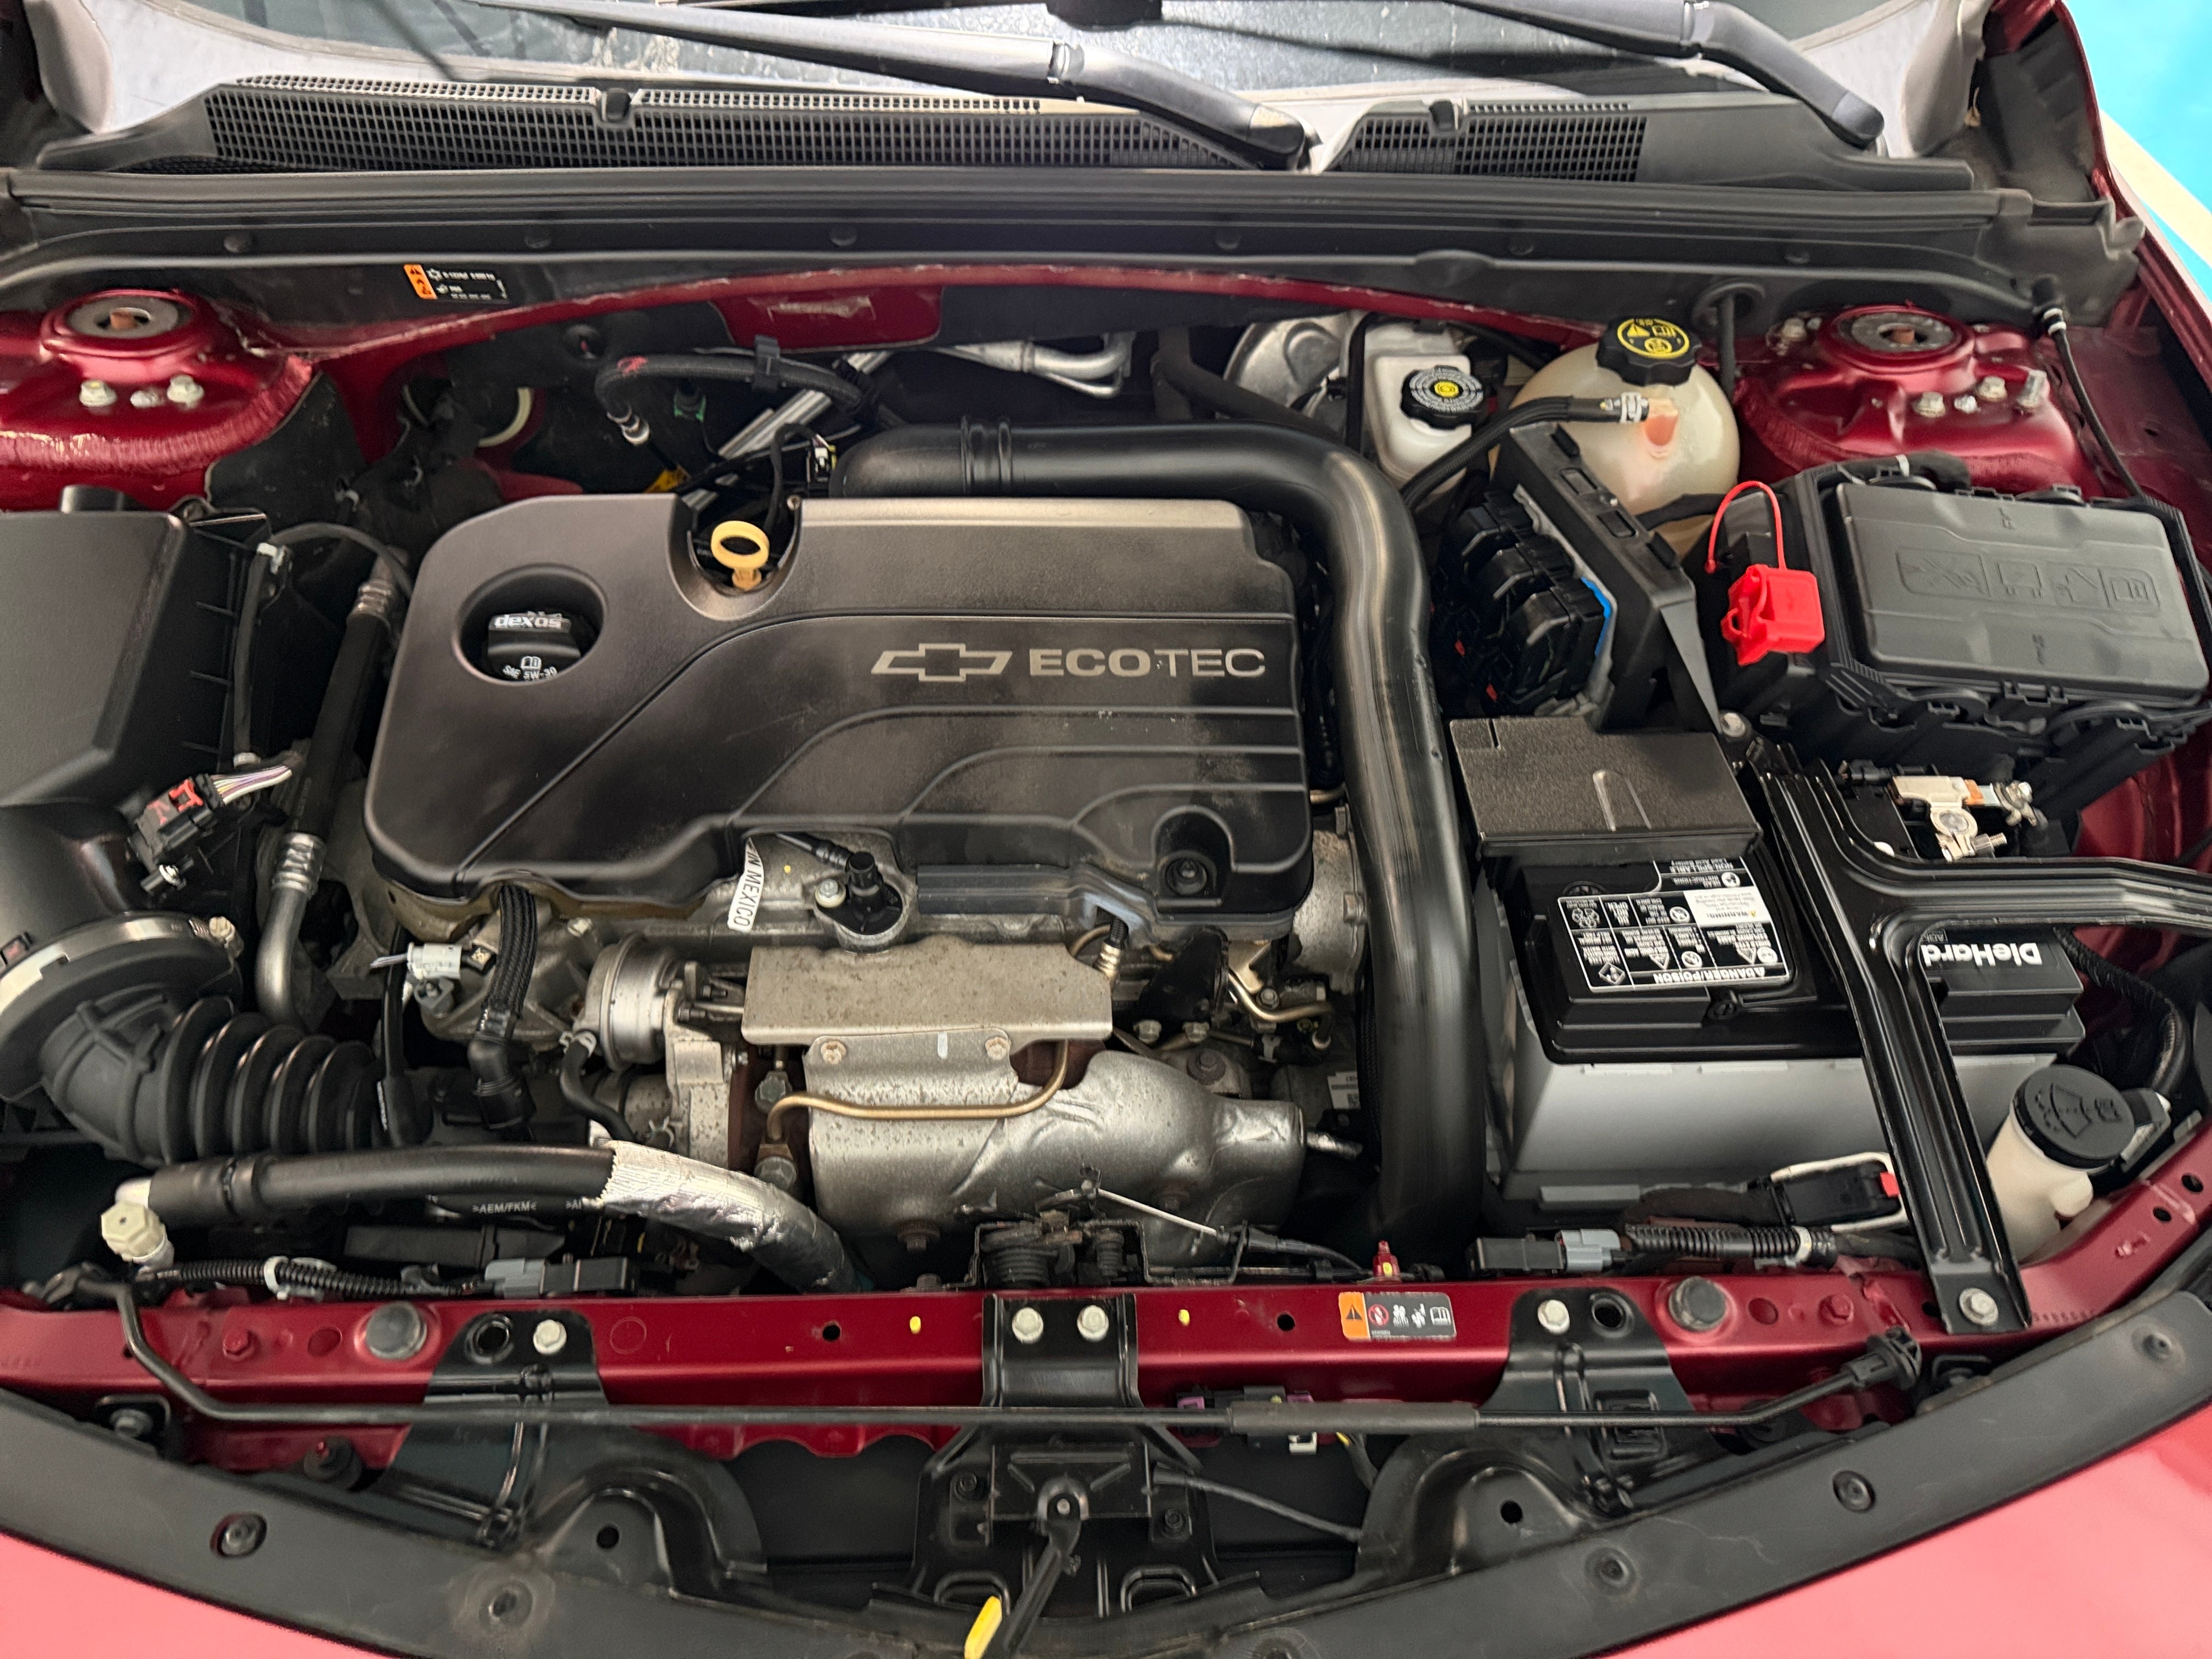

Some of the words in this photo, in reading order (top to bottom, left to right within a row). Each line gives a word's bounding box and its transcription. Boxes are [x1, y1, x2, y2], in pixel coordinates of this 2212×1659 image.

[494, 614, 562, 629] dexos
[1029, 648, 1266, 678] ECOTEC
[733, 869, 763, 927] MEXICO
[1921, 943, 2042, 967] DieHard
